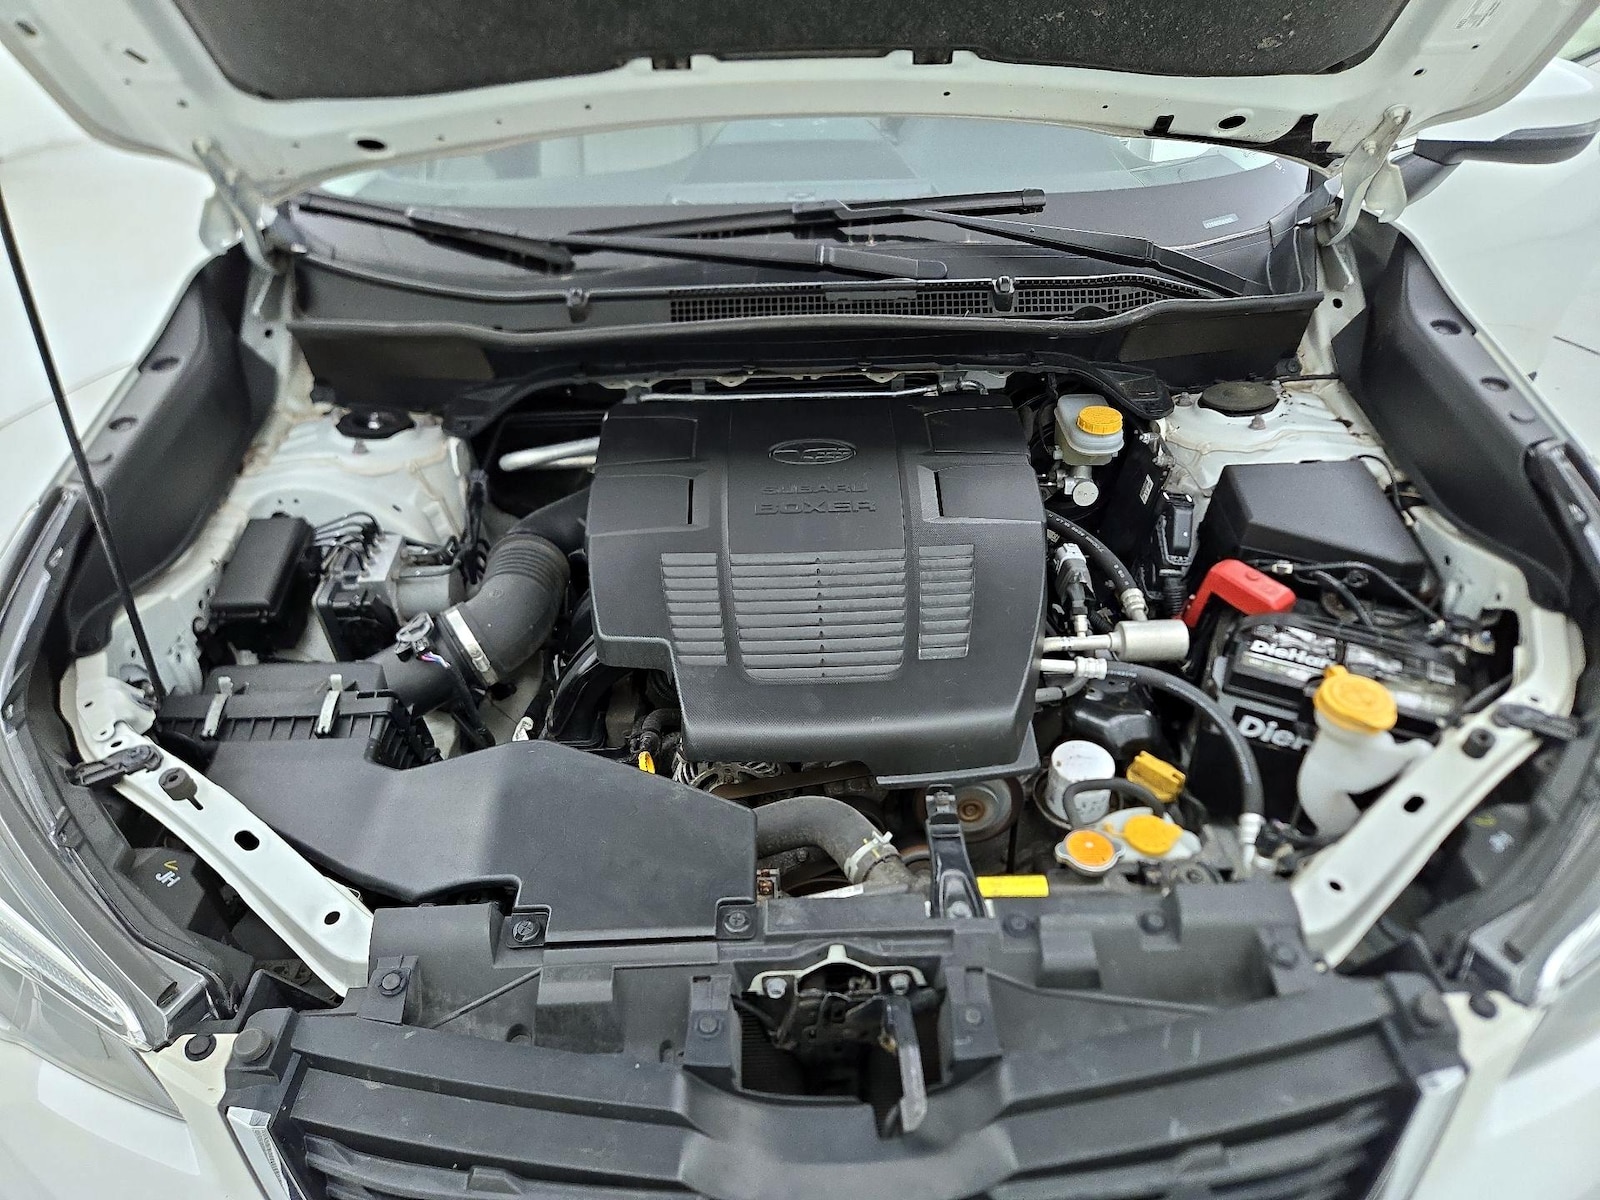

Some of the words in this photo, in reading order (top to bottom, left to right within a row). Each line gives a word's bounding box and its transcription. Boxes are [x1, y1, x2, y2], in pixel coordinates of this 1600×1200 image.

[763, 483, 868, 495] SUBARU
[754, 501, 876, 515] BOXER
[155, 870, 181, 888] JH
